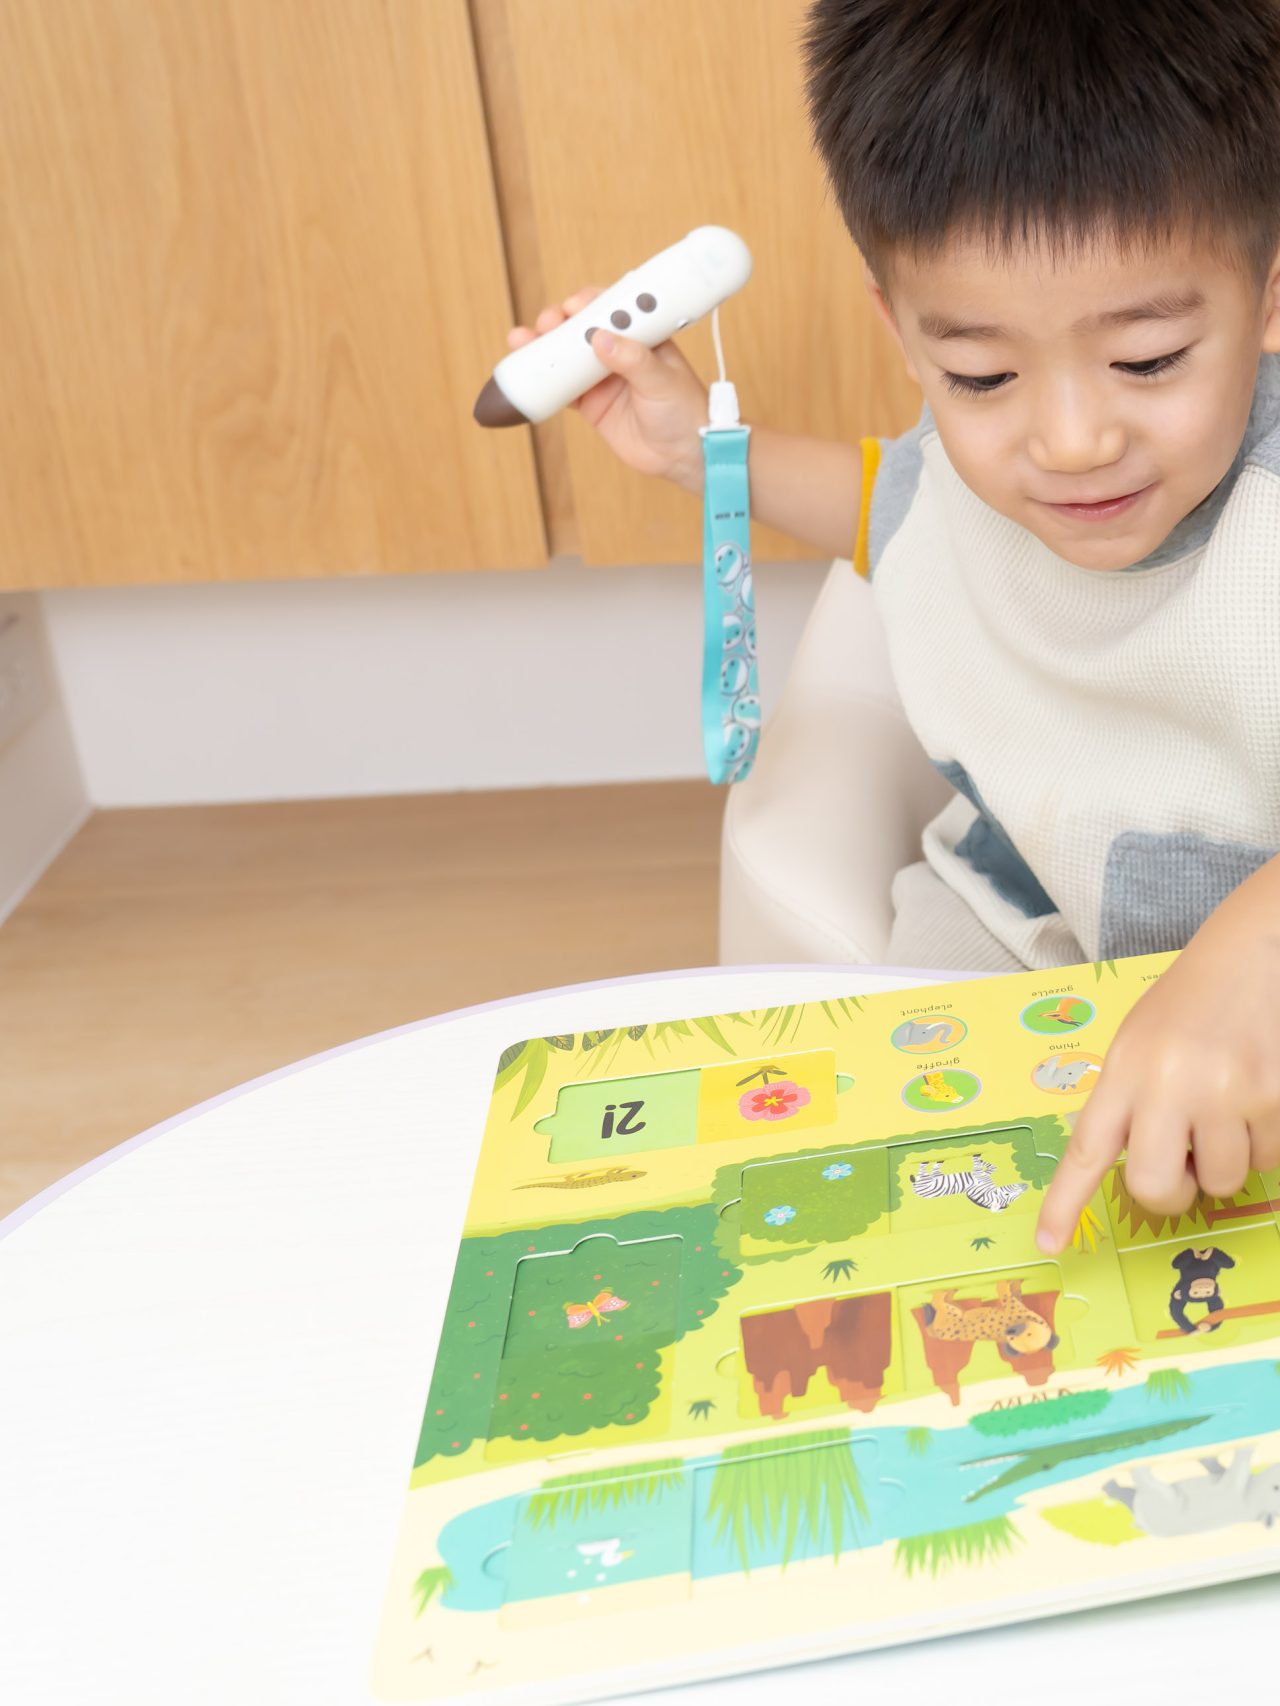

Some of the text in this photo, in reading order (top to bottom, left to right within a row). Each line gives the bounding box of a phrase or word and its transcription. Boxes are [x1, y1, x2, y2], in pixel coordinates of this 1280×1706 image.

[1031, 985, 1074, 998] gazelle
[900, 1003, 953, 1016] elephant
[1049, 1041, 1080, 1052] rhino
[916, 1057, 960, 1071] giraffe
[601, 1100, 646, 1139] 2!
